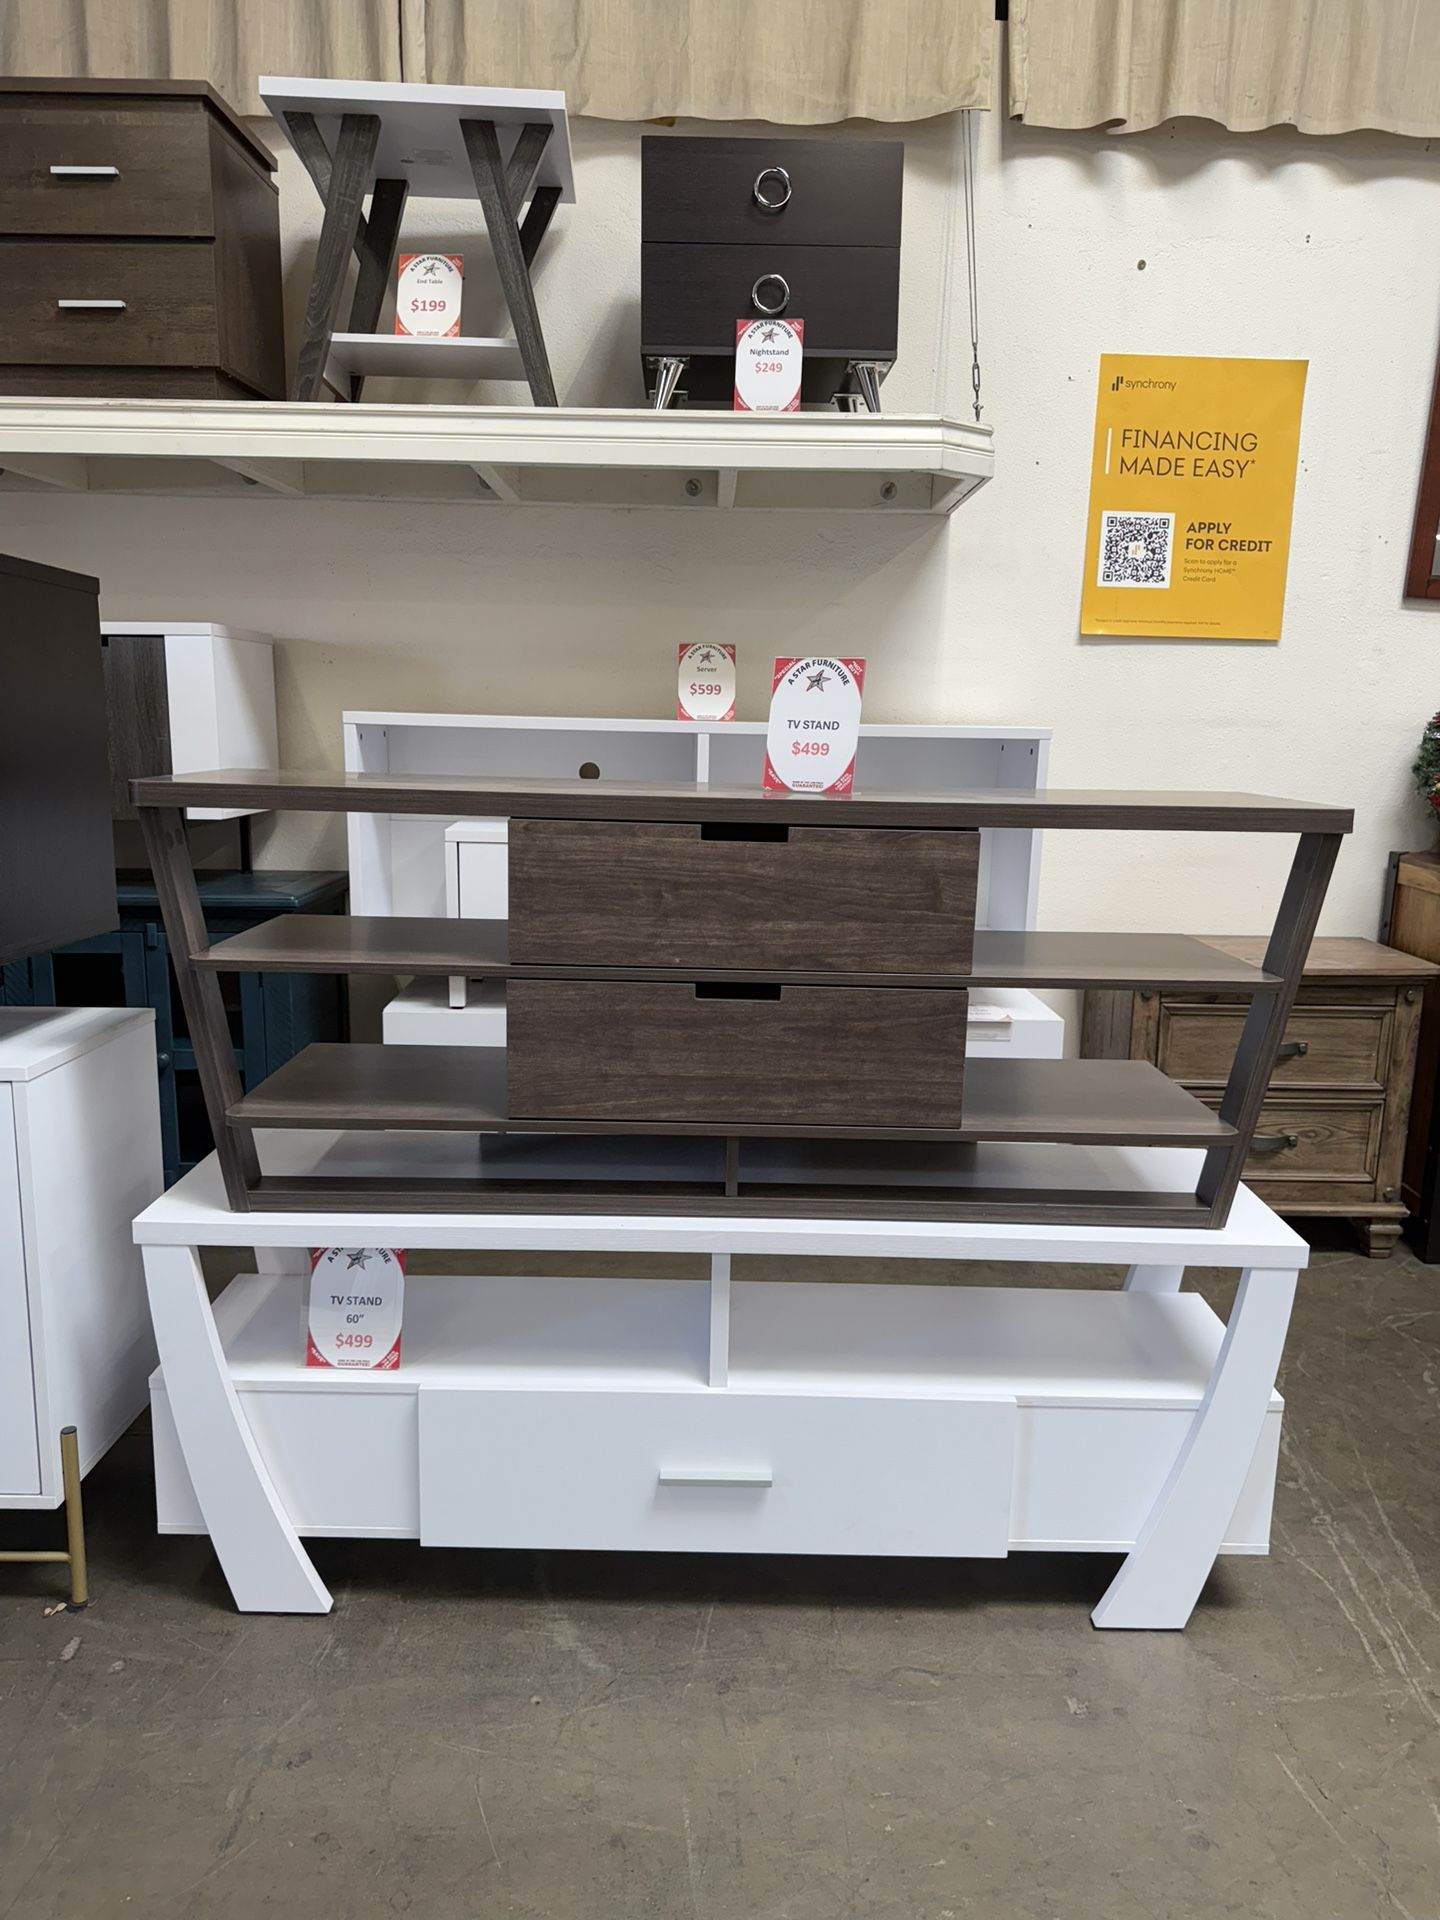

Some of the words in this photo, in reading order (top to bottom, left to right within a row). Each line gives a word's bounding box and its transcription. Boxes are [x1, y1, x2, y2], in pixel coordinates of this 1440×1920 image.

[413, 257, 426, 268] STAR
[426, 256, 454, 272] FURNITURE
[411, 298, 446, 313] $199
[752, 322, 765, 334] STAR
[765, 321, 793, 339] FURNITURE
[755, 362, 783, 374] $249
[1125, 378, 1177, 391] synchrony
[1121, 428, 1258, 452] FINANCING
[1119, 456, 1185, 477] MADE
[1186, 522, 1232, 534] APPLY
[1186, 538, 1214, 550] FOR
[1218, 539, 1272, 552] CREDIT
[691, 646, 702, 656] STAR
[702, 644, 727, 660] FURNITURE
[792, 661, 811, 678] STAR
[812, 659, 851, 686] FURNITURE
[690, 682, 722, 696] $599
[787, 719, 801, 729] TV
[803, 720, 840, 731] STAND
[792, 740, 830, 756] $499
[330, 1295, 344, 1305] TV
[346, 1296, 383, 1306] STAND
[335, 1332, 373, 1349] $499
